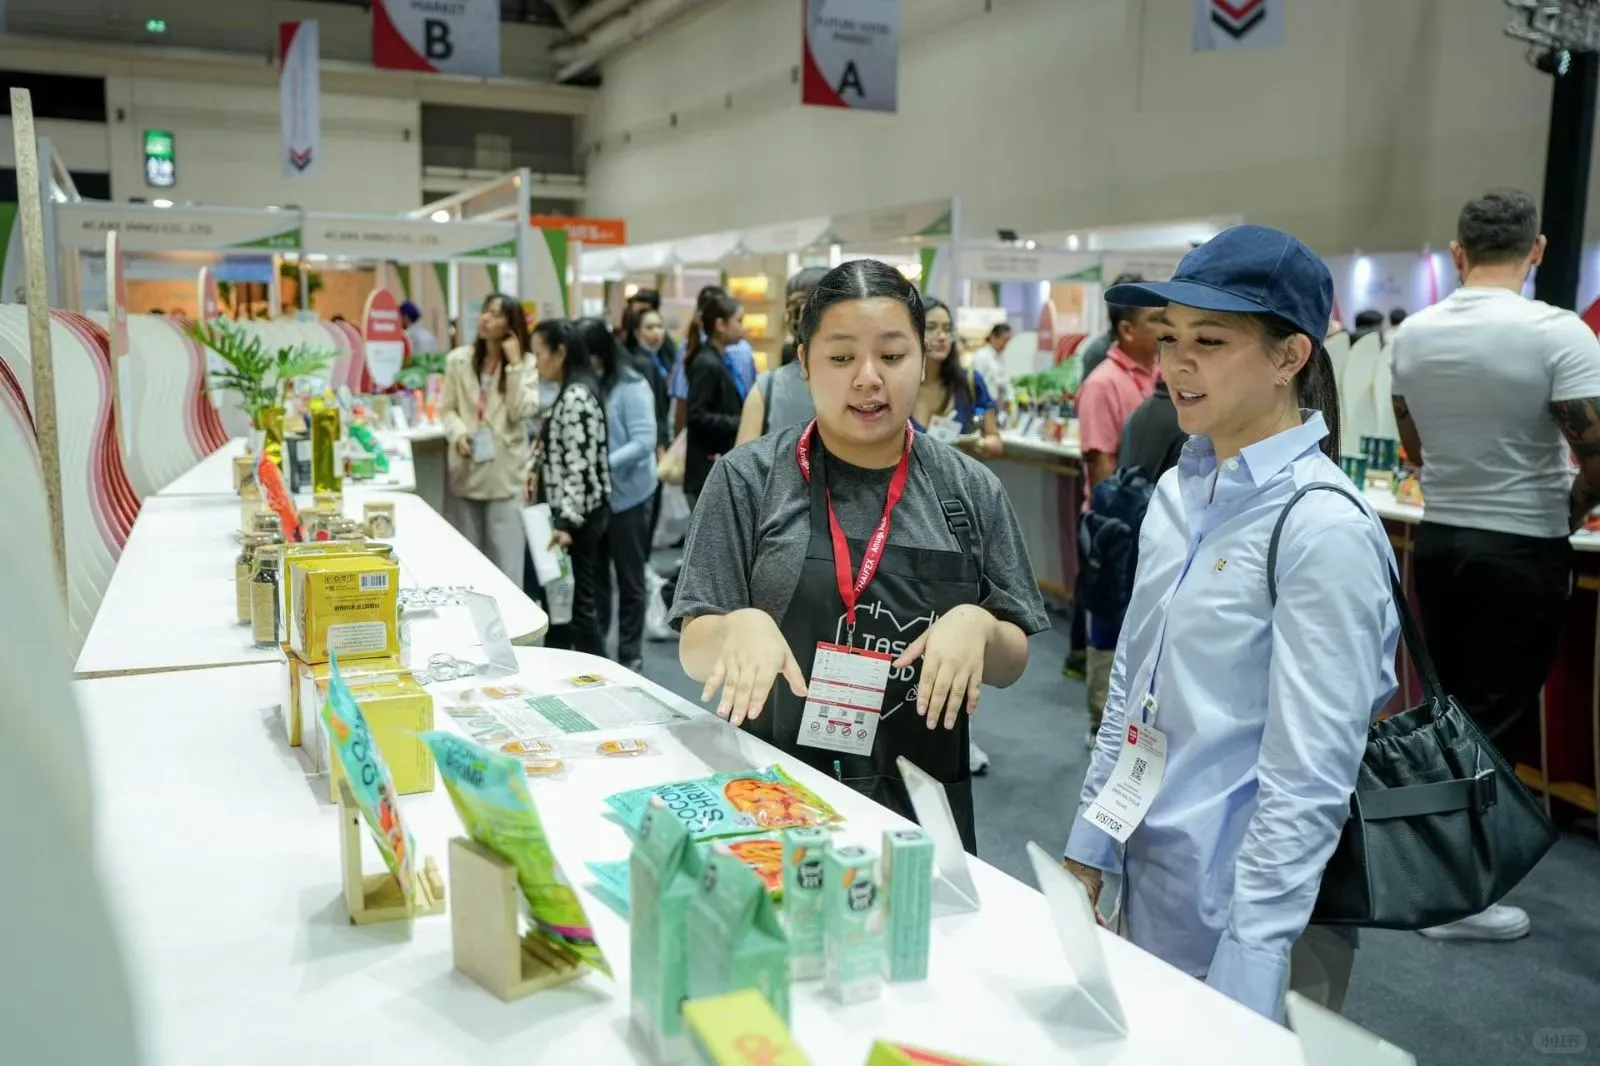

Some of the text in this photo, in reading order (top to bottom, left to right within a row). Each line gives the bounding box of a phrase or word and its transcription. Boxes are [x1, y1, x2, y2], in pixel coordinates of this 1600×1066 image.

[424, 18, 453, 60] B
[837, 60, 867, 98] A
[855, 558, 875, 592] THAIFEX
[871, 531, 885, 553] Anuga
[862, 633, 908, 658] TAS
[1095, 811, 1123, 833] VISITOR
